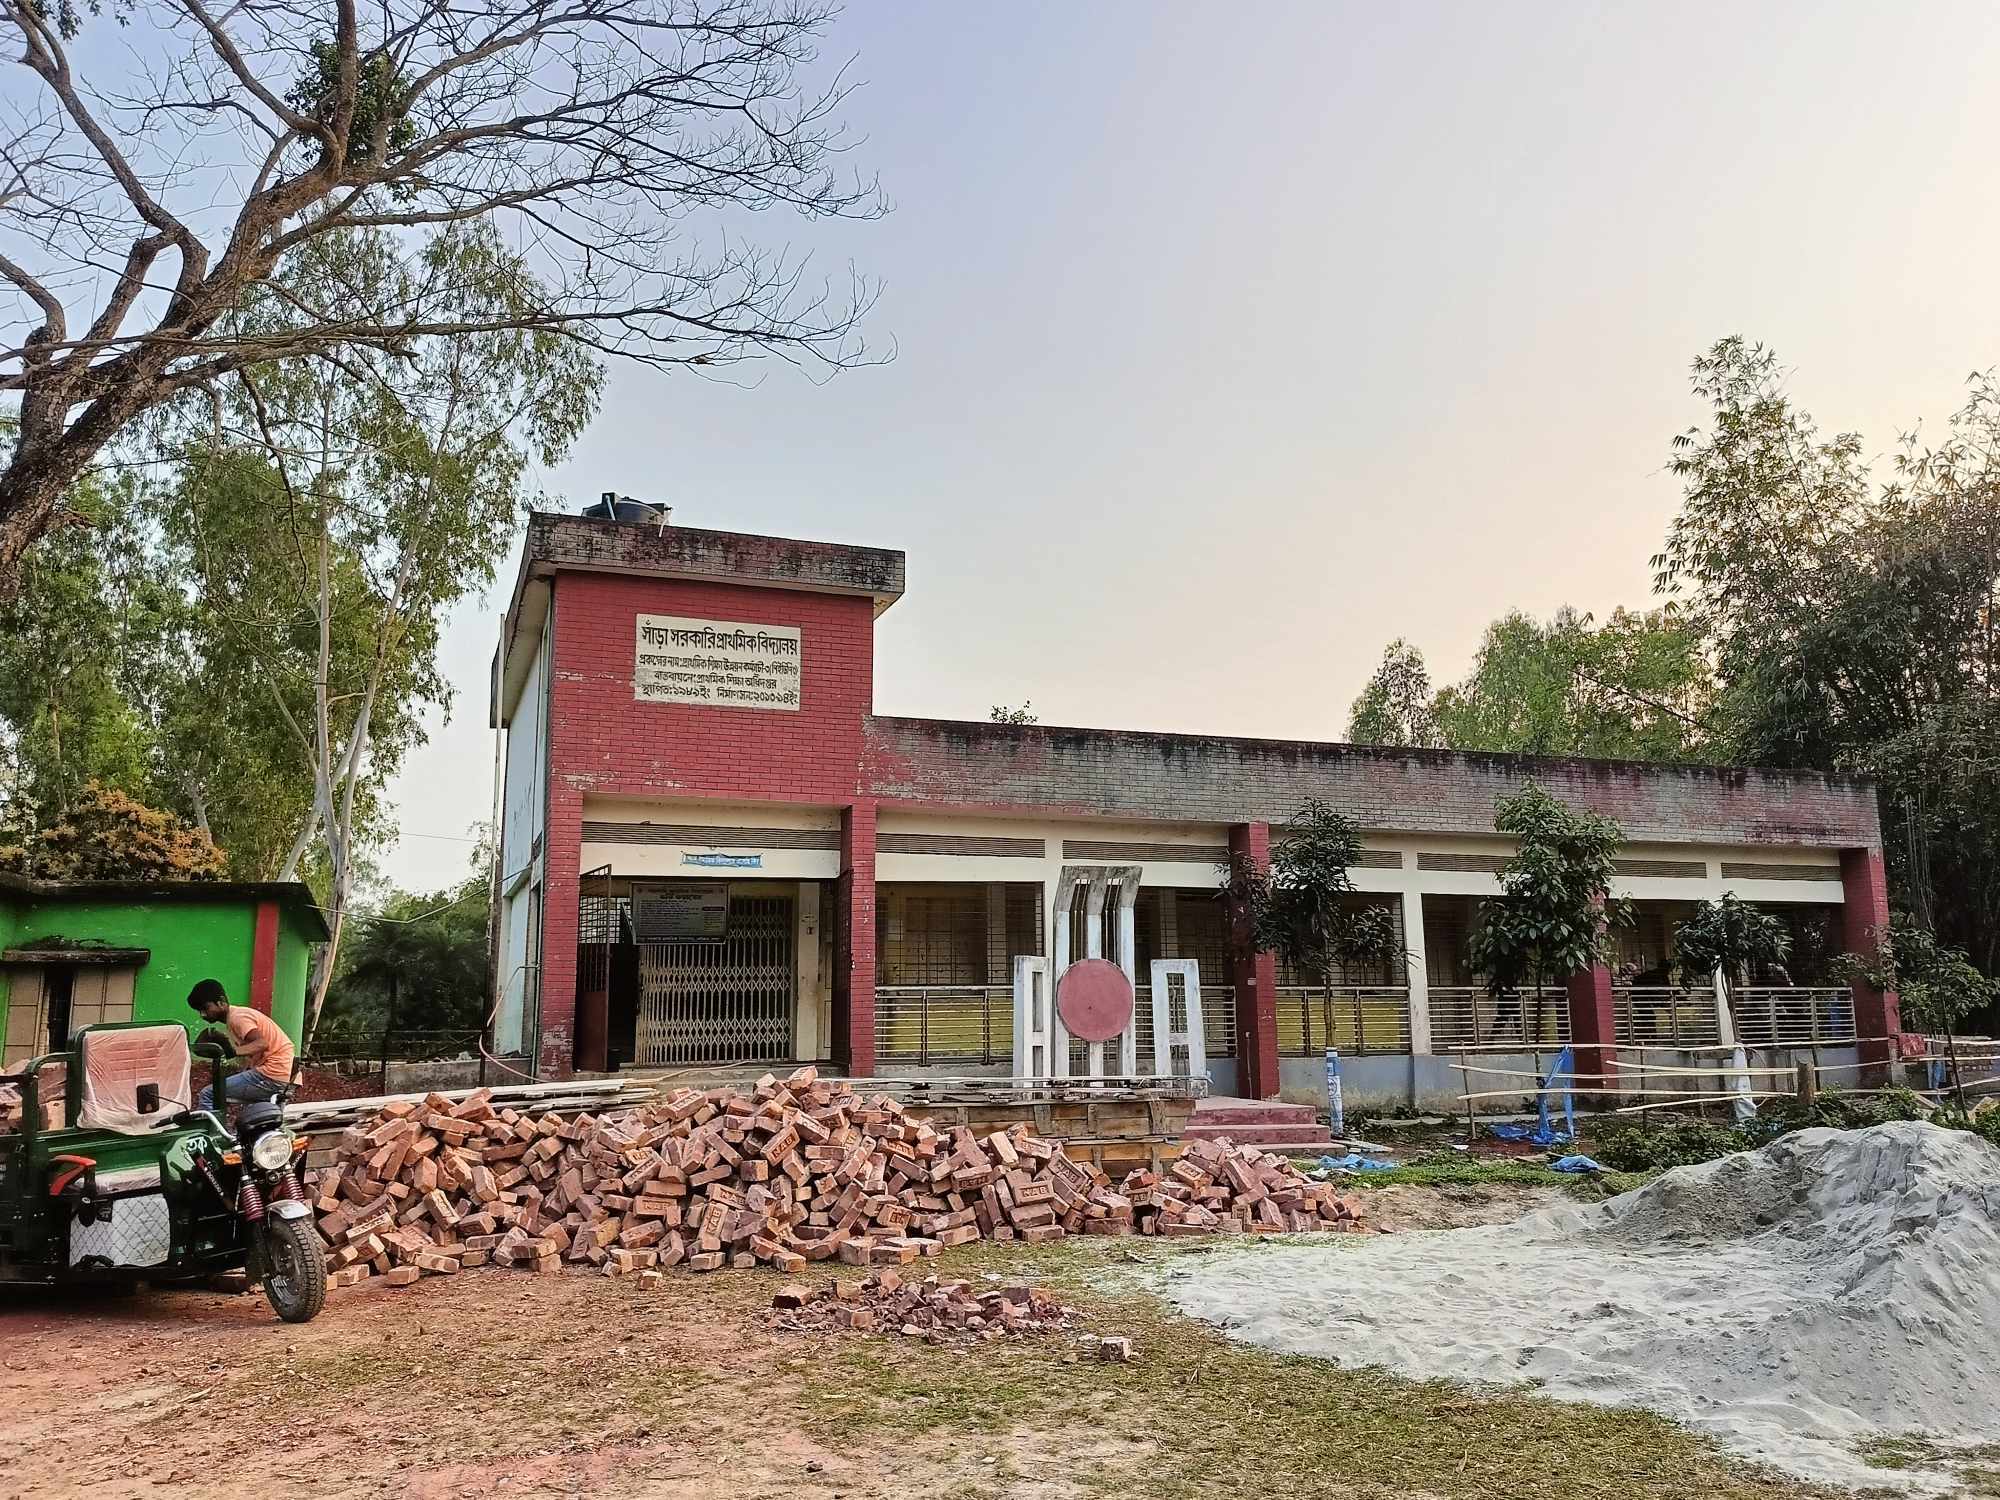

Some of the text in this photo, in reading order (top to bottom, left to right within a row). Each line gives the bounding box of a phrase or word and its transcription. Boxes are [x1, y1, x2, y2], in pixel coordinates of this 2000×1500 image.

[670, 626, 716, 649] সরকারি
[716, 629, 757, 653] প্রাথমিক
[757, 631, 798, 655] বিদ্যালয়
[771, 1133, 796, 1158] NAB
[1056, 1161, 1080, 1183] NAB
[1022, 1185, 1049, 1197] NAB
